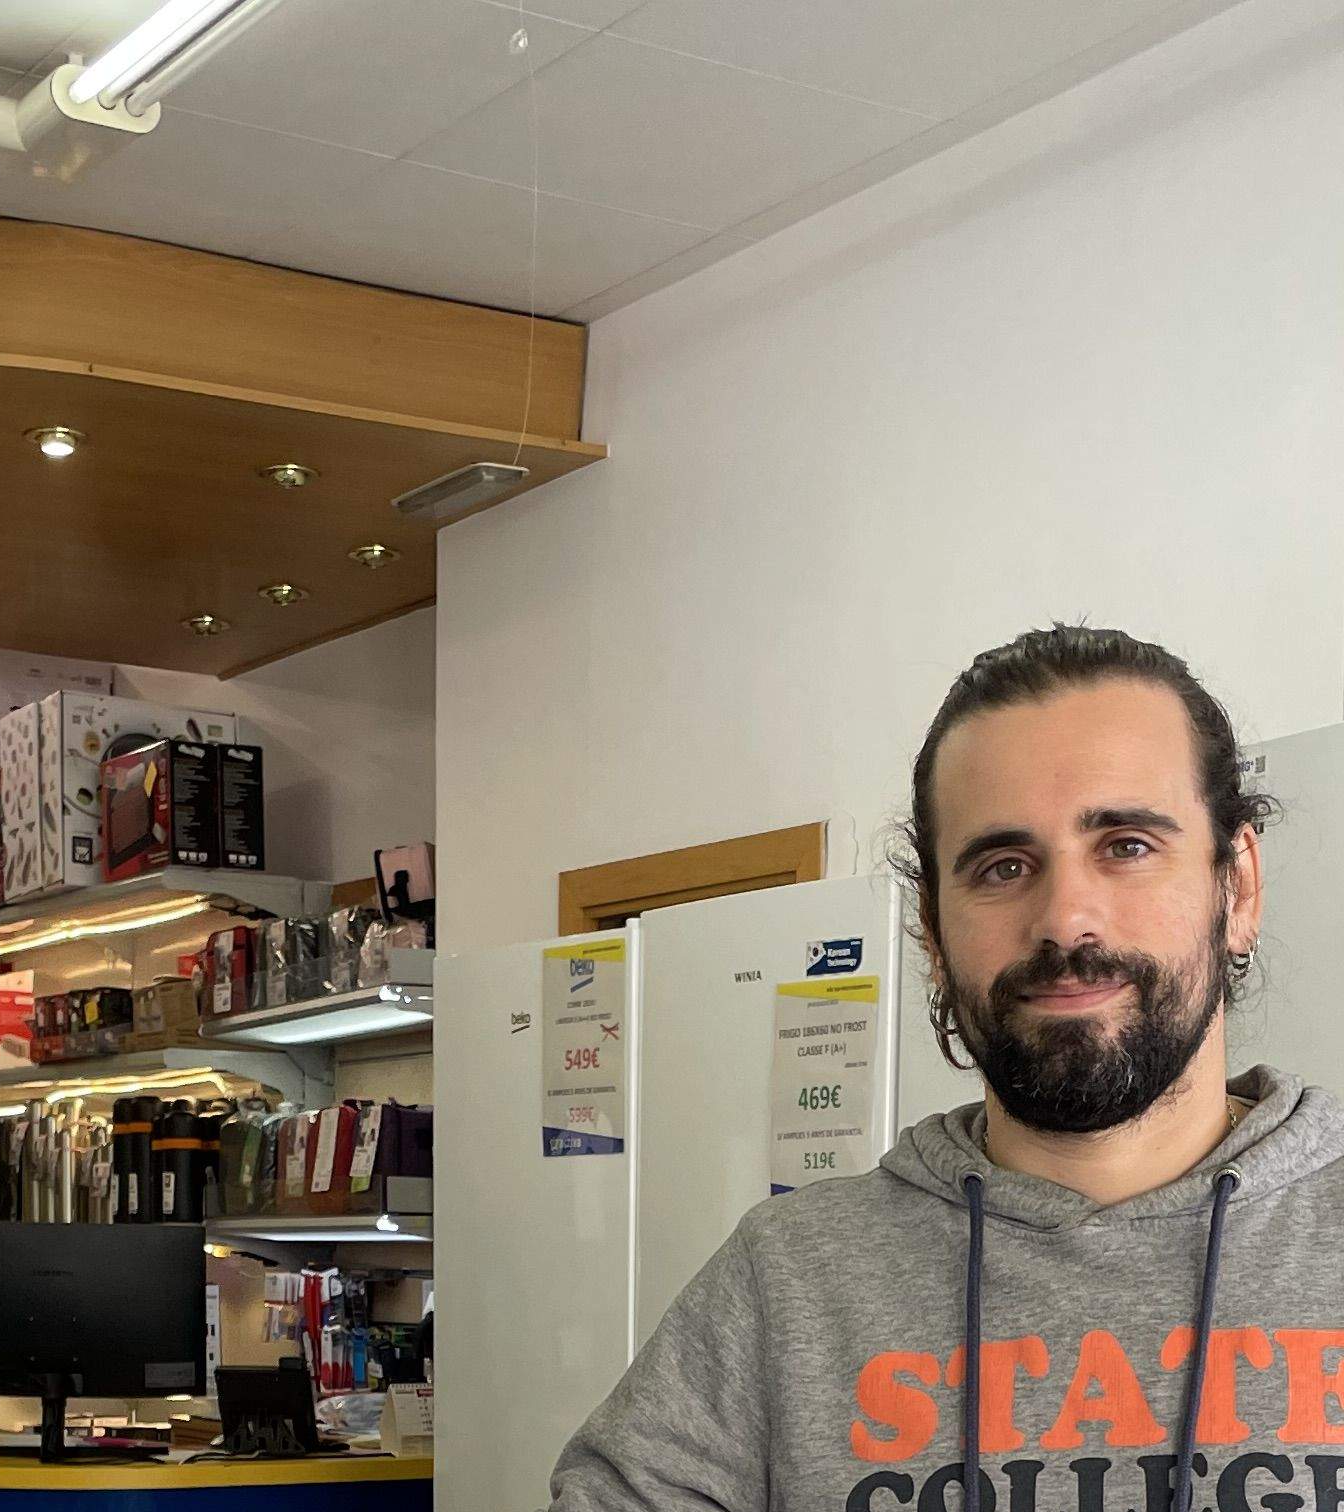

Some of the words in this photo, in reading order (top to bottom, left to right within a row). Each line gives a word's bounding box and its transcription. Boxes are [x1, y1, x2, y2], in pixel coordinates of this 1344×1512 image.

[570, 958, 594, 976] beko
[511, 1012, 531, 1025] beko
[830, 1023, 842, 1034] NO
[844, 1020, 867, 1033] FROST
[565, 1047, 600, 1071] 549€
[797, 1045, 823, 1057] CLASSE
[798, 1085, 842, 1111] 469€
[804, 1151, 835, 1170] 519€
